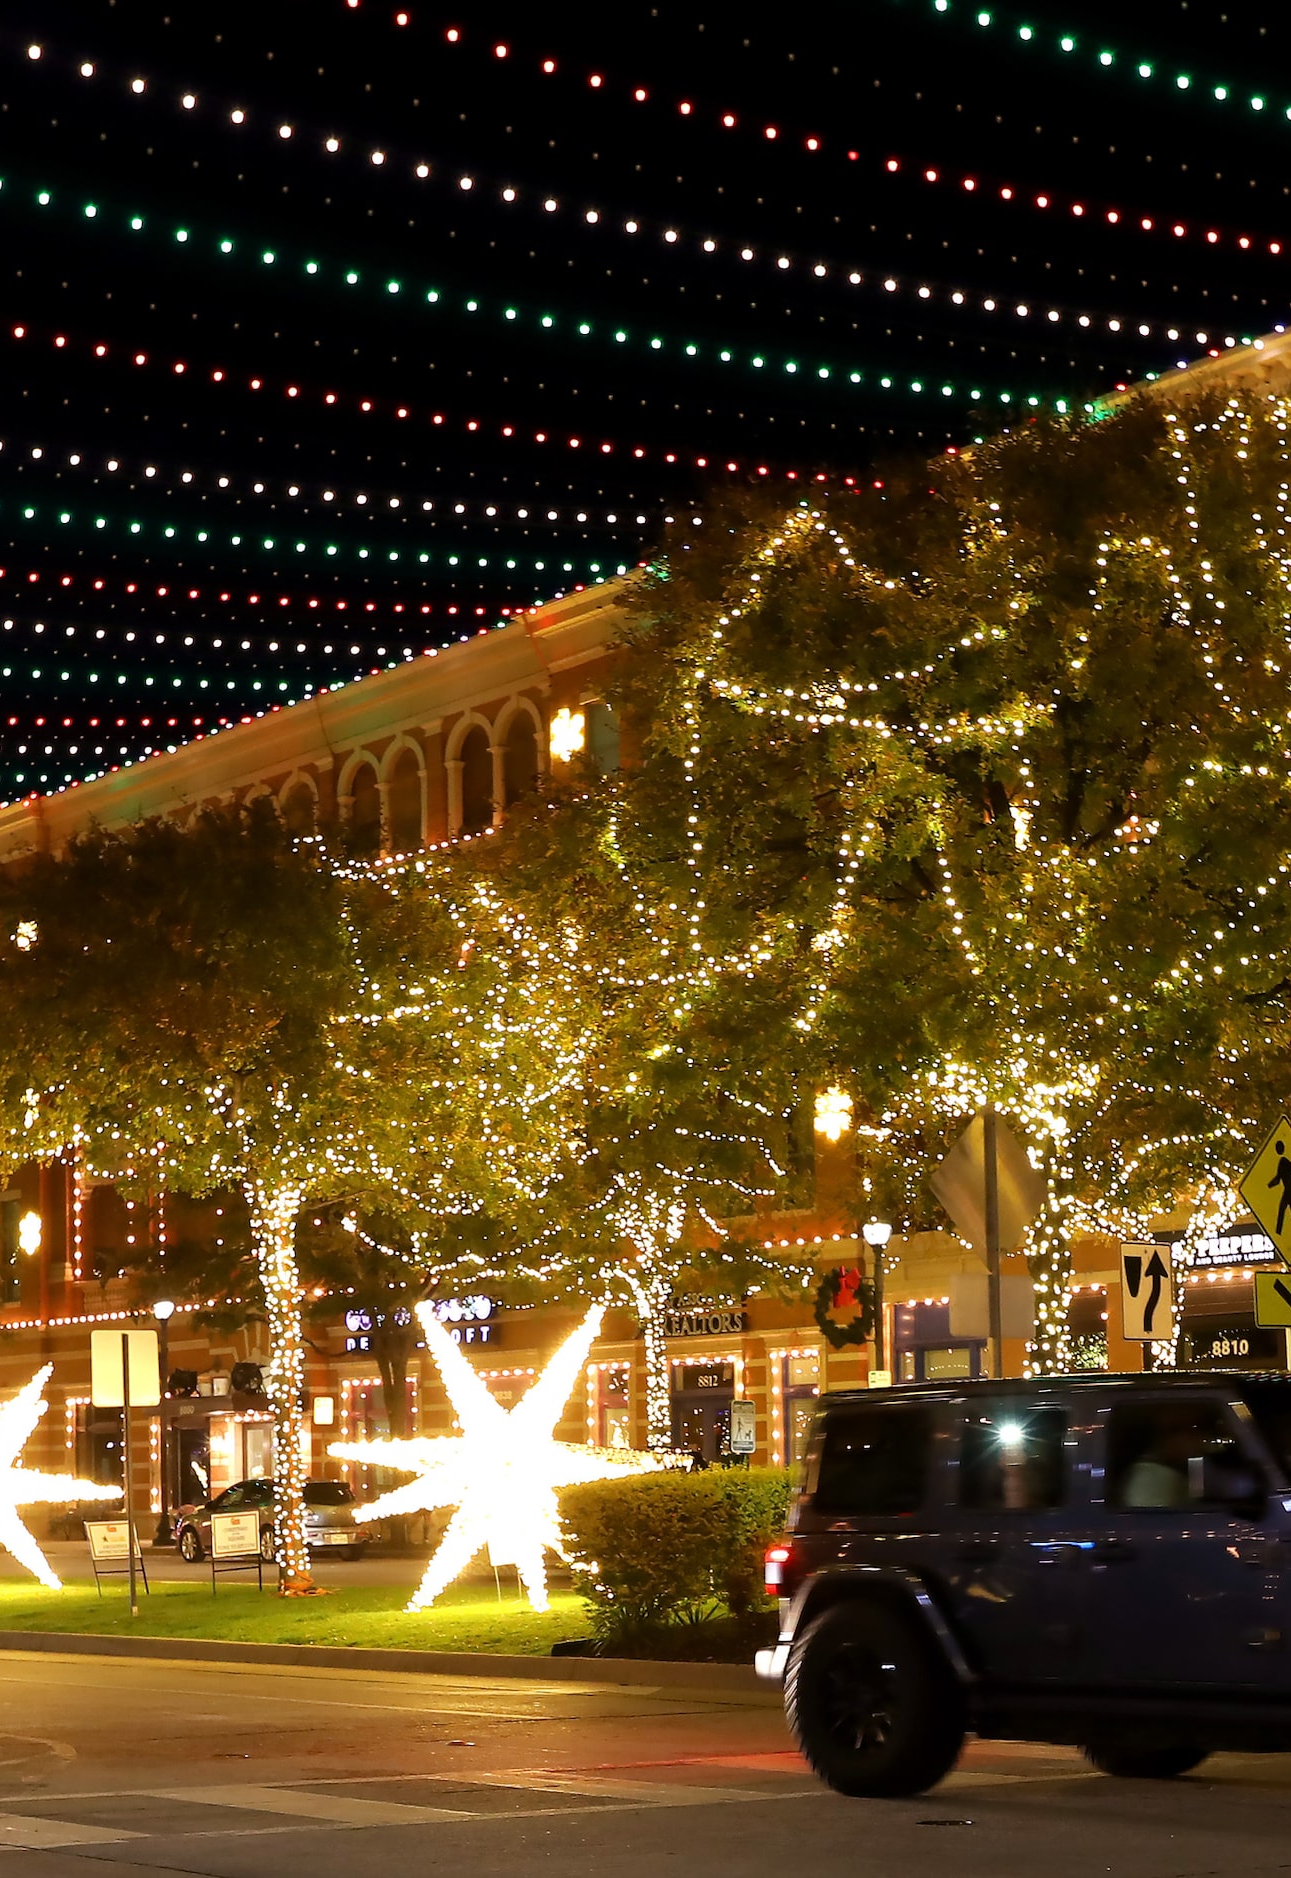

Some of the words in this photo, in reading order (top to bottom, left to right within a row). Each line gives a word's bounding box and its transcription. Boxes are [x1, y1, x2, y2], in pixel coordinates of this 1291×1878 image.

[662, 1311, 743, 1336] REALTORS
[1212, 1339, 1249, 1356] 8810
[697, 1375, 719, 1388] 8812
